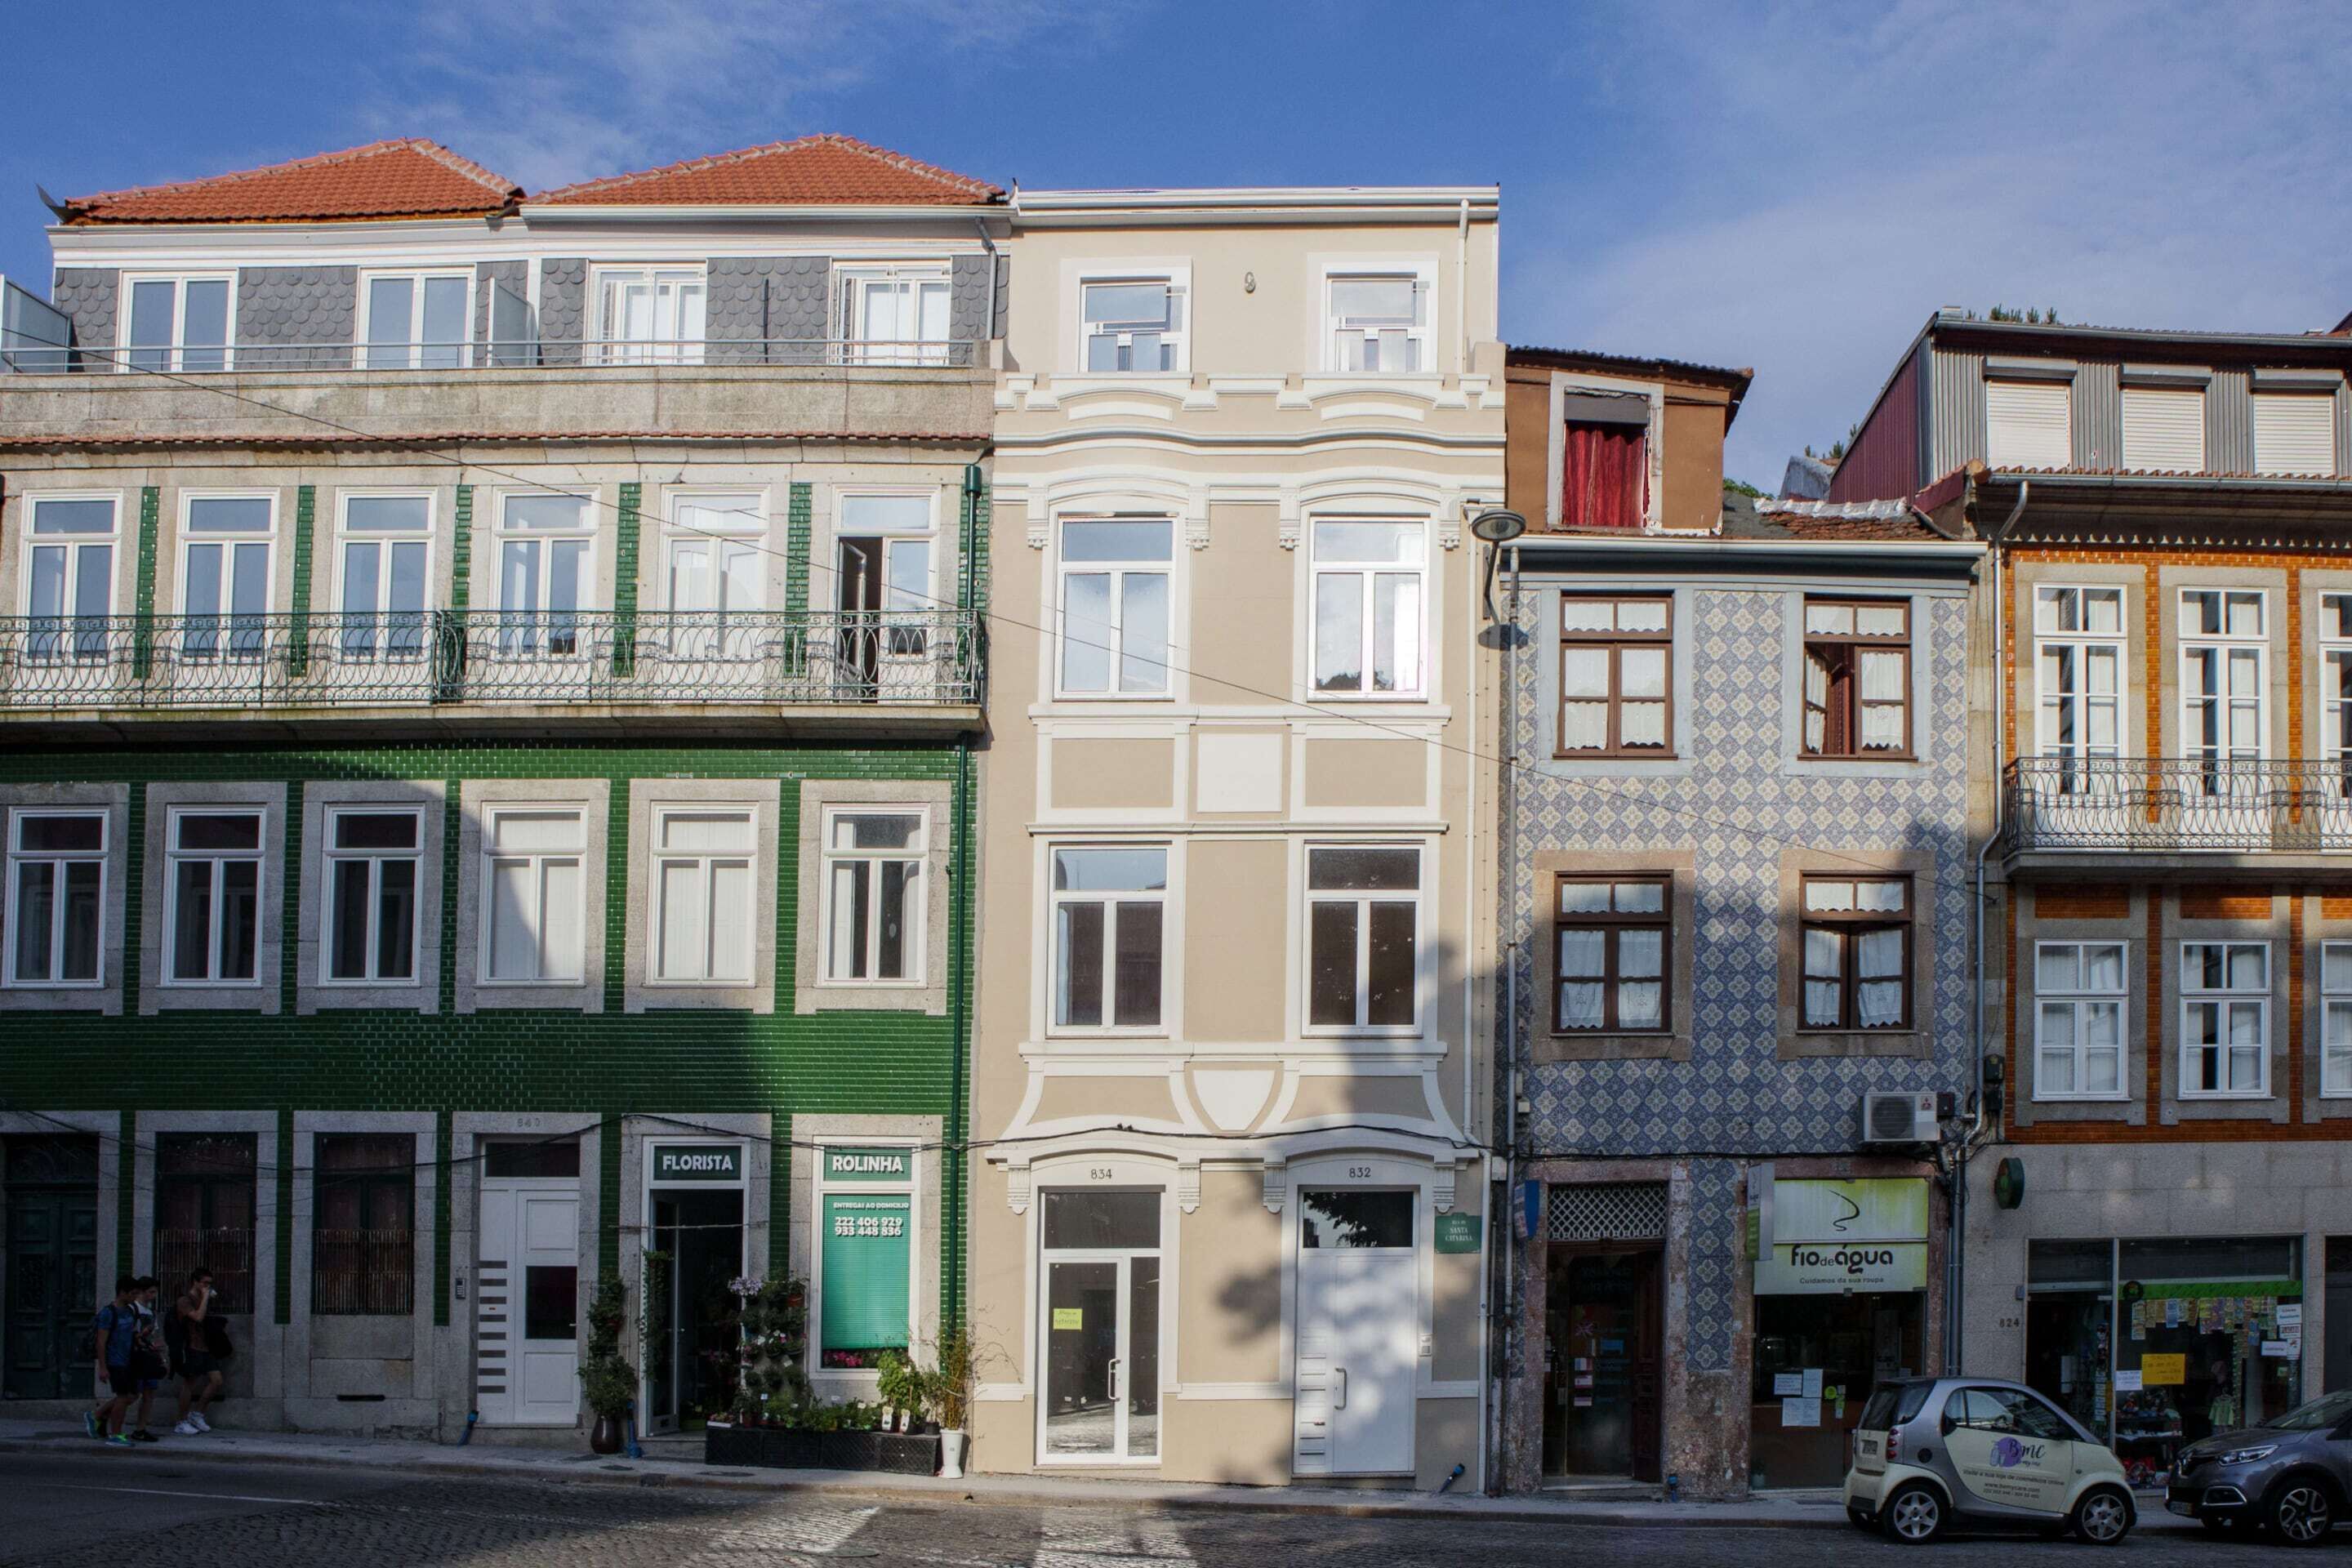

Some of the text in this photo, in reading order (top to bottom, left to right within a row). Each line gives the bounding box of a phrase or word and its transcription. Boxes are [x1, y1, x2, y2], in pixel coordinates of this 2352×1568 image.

[662, 1154, 733, 1170] FLORISTA
[832, 1155, 904, 1173] ROLINHA
[1090, 1169, 1112, 1179] 834
[1349, 1167, 1371, 1178] 832
[835, 1217, 903, 1227] 222 406 929
[835, 1227, 902, 1236] 933 448 836
[1863, 1276, 1884, 1285] roupa
[1999, 1317, 2020, 1327] 824
